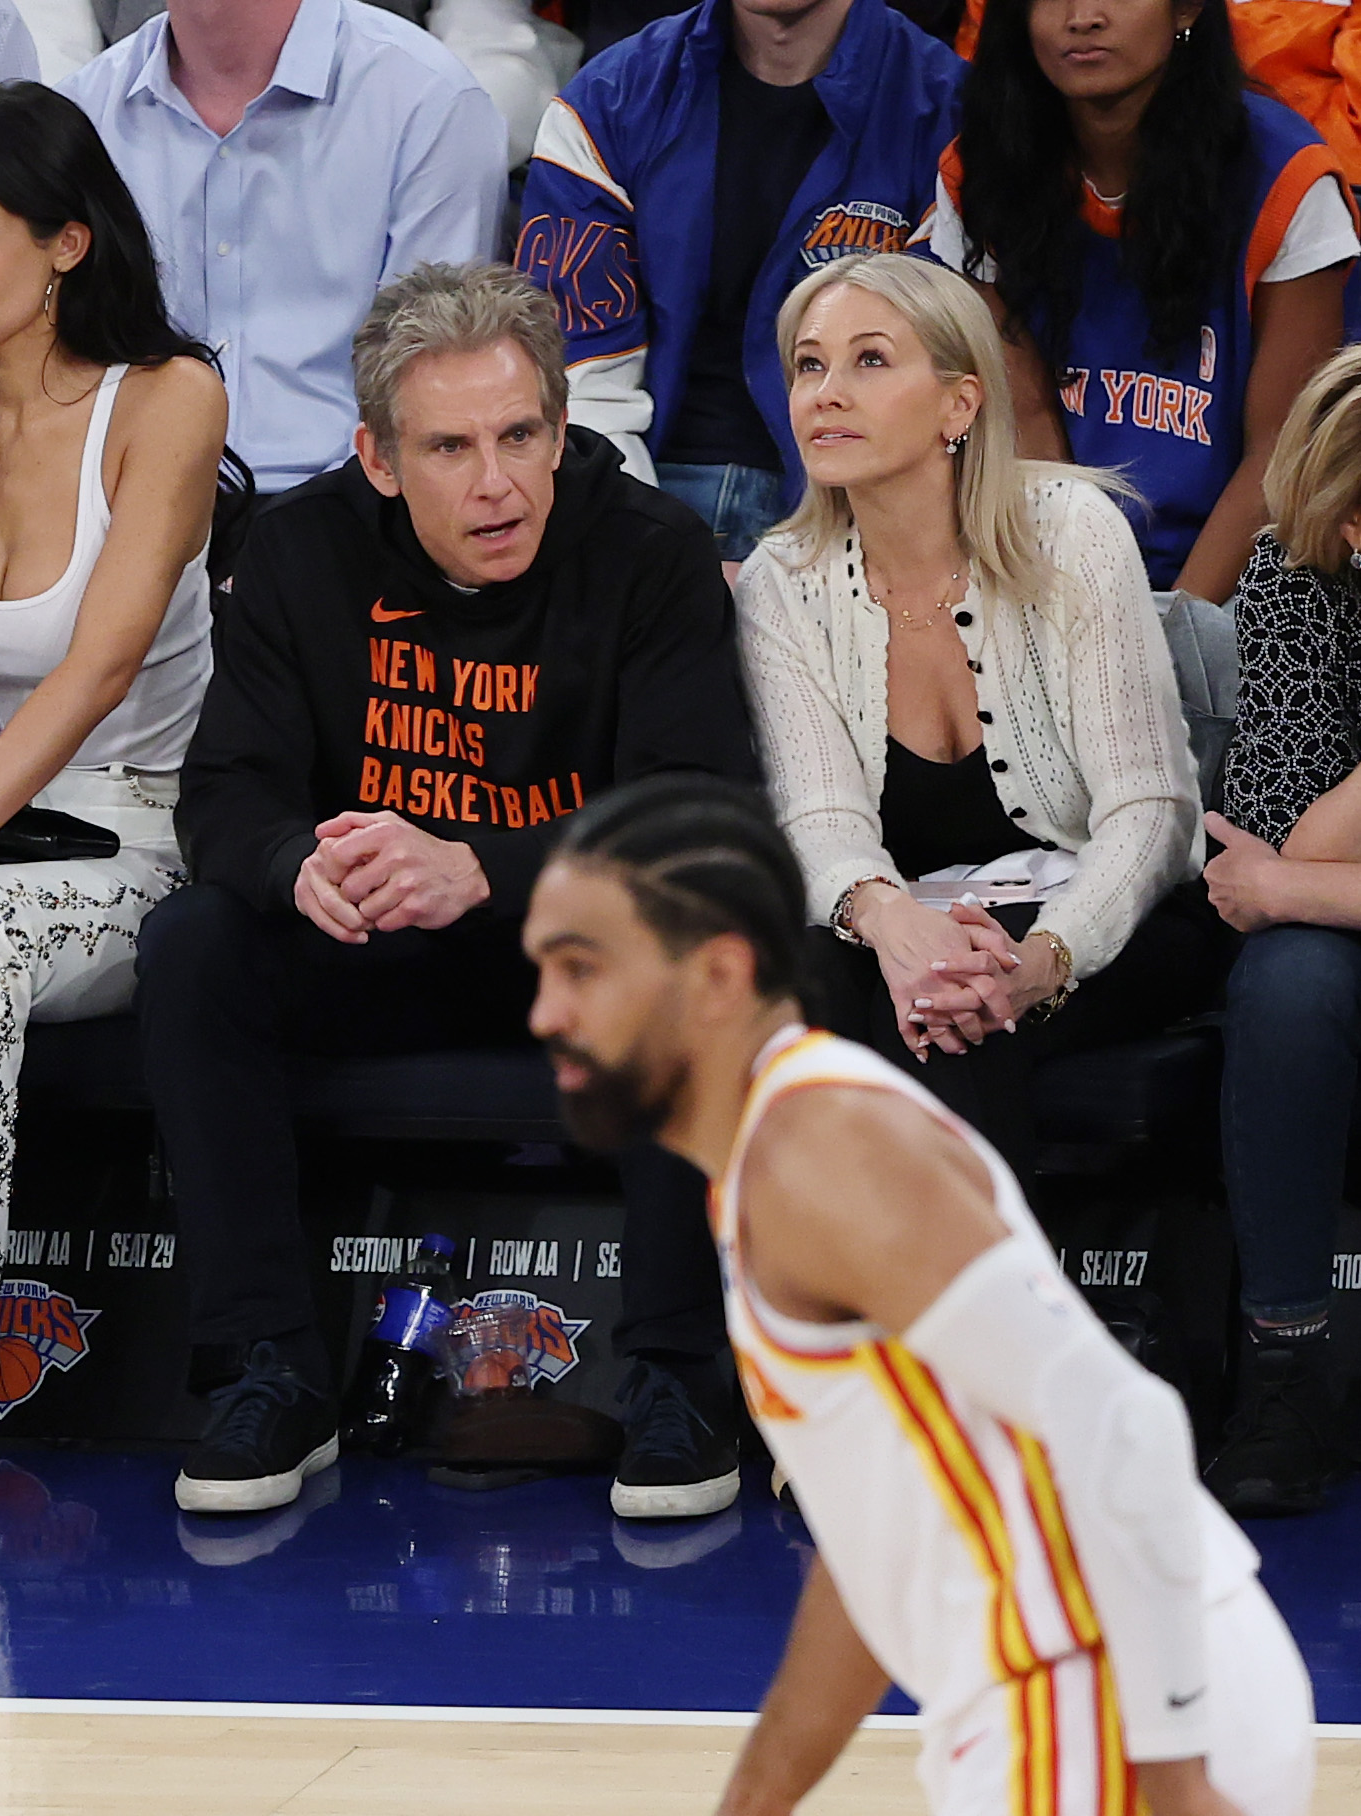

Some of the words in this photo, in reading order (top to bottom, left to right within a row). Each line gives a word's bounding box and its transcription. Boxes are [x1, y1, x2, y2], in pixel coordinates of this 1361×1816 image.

[513, 213, 639, 332] CKS
[1100, 369, 1213, 446] YORK
[369, 637, 436, 694] NEW
[452, 658, 540, 713] YORK
[364, 697, 485, 768] KNICKS
[47, 1231, 71, 1266] AA
[108, 1232, 152, 1268] SEAT
[151, 1233, 176, 1268] 29
[330, 1236, 404, 1274] SECTION
[489, 1240, 535, 1276] ROW
[534, 1241, 559, 1277] AA
[596, 1242, 622, 1278] SE
[1080, 1250, 1122, 1286] SEAT
[1123, 1251, 1148, 1287] 27
